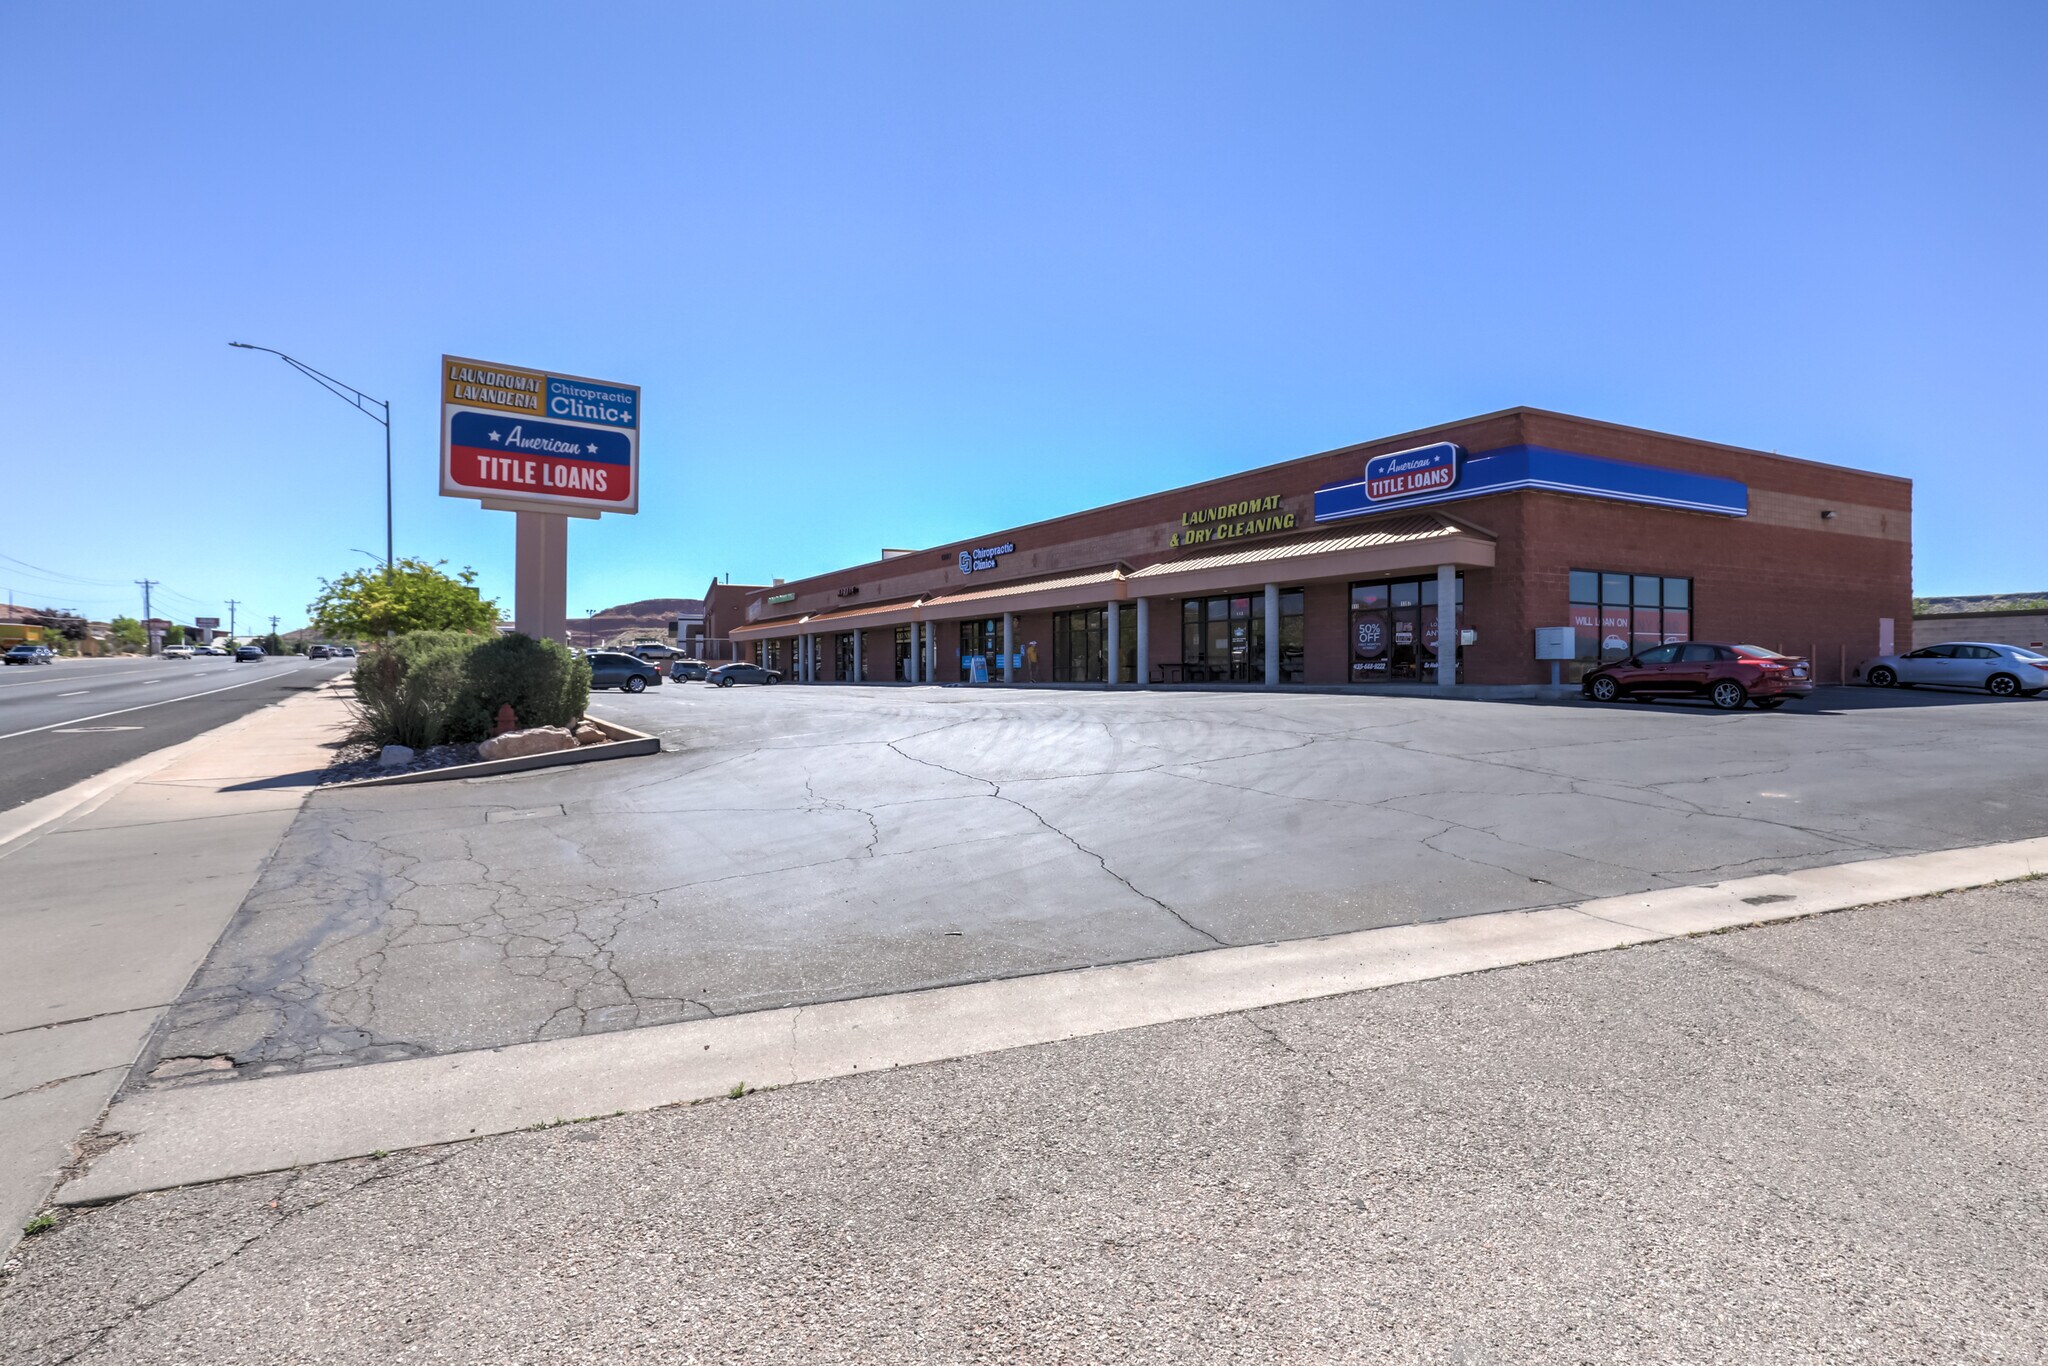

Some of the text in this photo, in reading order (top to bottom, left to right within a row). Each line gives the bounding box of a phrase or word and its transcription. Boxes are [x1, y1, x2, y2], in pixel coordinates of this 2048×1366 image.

[449, 366, 542, 393] LAUNDROMAT
[454, 384, 538, 409] LAVANDERIA
[551, 382, 632, 404] Chiropractic
[505, 425, 581, 455] American
[477, 455, 608, 492] TITLE LOANS
[1386, 459, 1431, 474] American
[1371, 468, 1449, 496] TITLE LOANS
[1181, 494, 1281, 527] LAUNDROMAT
[1169, 513, 1295, 548] & DRY CLEANING
[972, 542, 1014, 559] Chiropractic
[1359, 623, 1380, 634] 50%
[1574, 616, 1593, 626] WILL
[1617, 617, 1628, 628] ON
[1359, 633, 1380, 642] OFF
